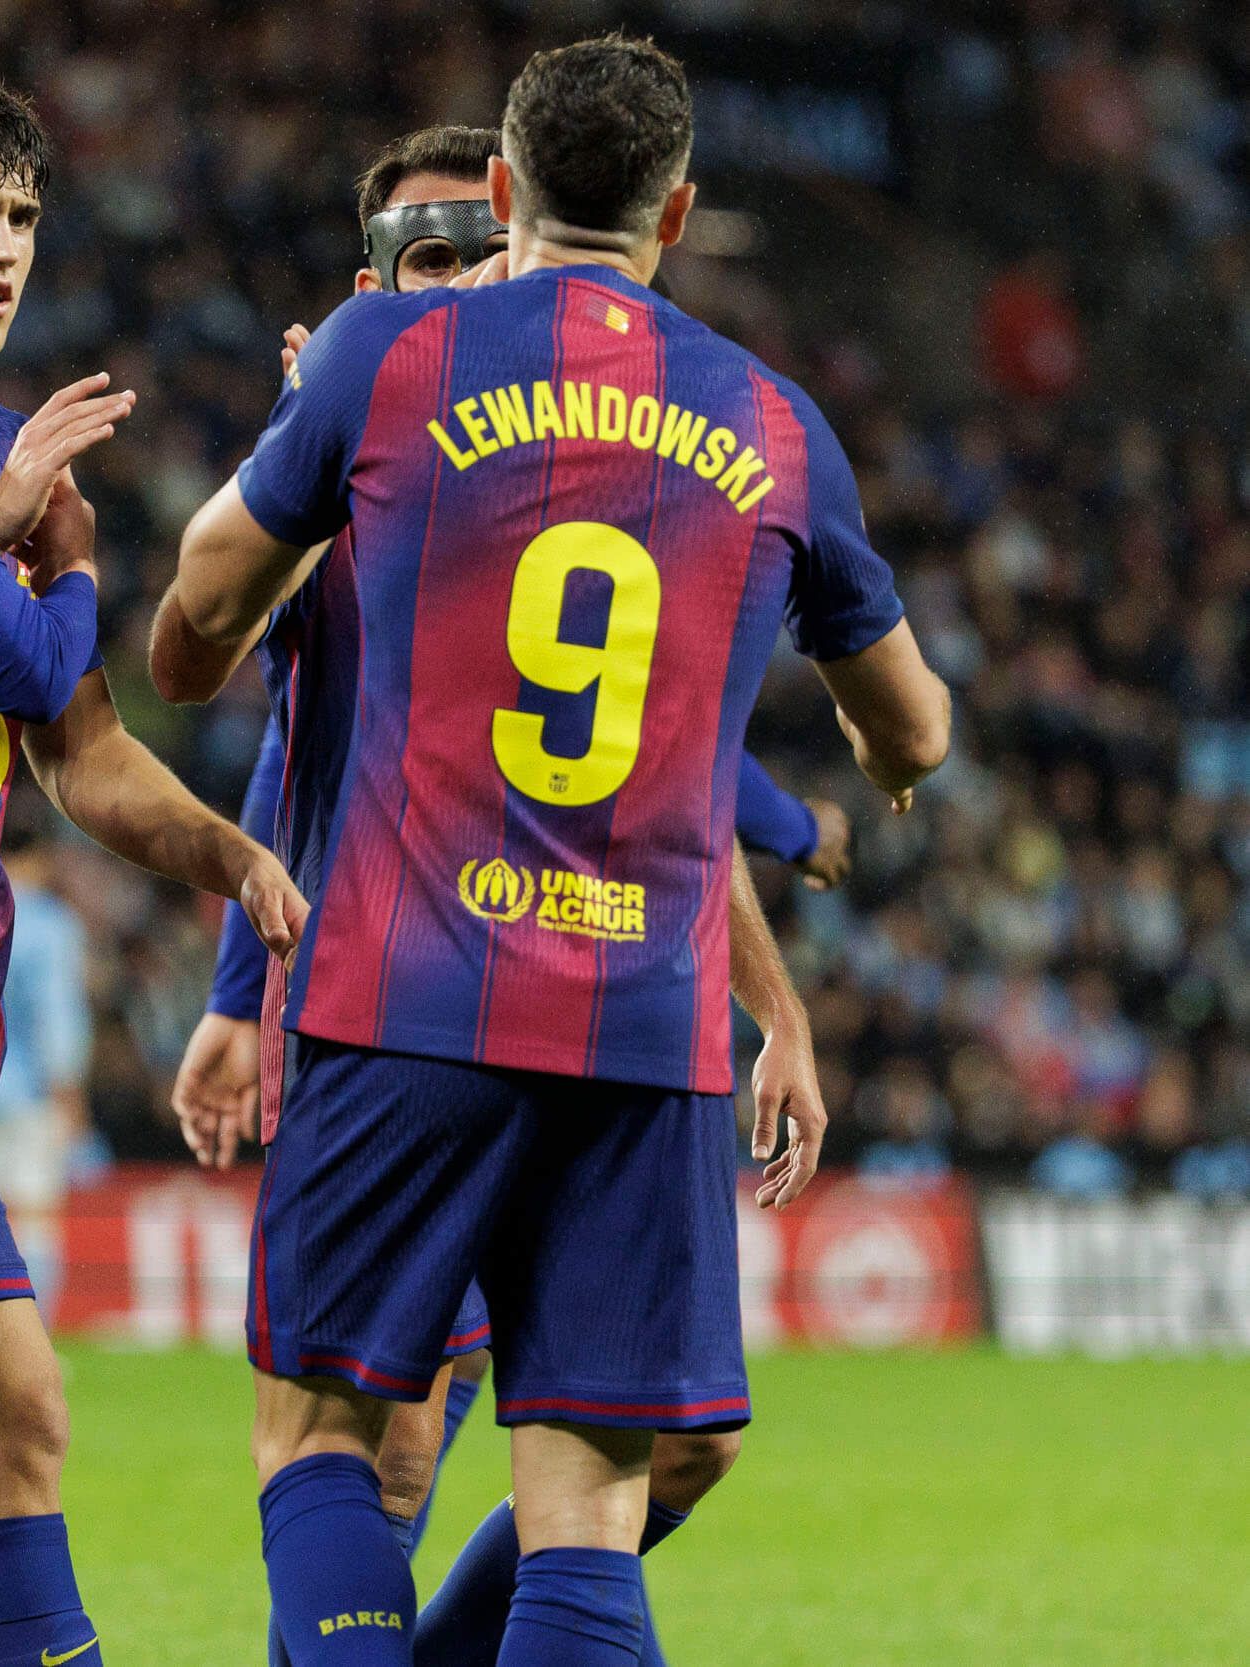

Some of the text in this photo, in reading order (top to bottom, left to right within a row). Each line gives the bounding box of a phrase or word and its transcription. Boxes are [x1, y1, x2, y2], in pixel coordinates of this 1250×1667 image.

[426, 379, 775, 514] LEWANDOWSKI
[490, 520, 663, 808] 9
[536, 894, 646, 933] ACNUR
[540, 868, 646, 910] UNHCR
